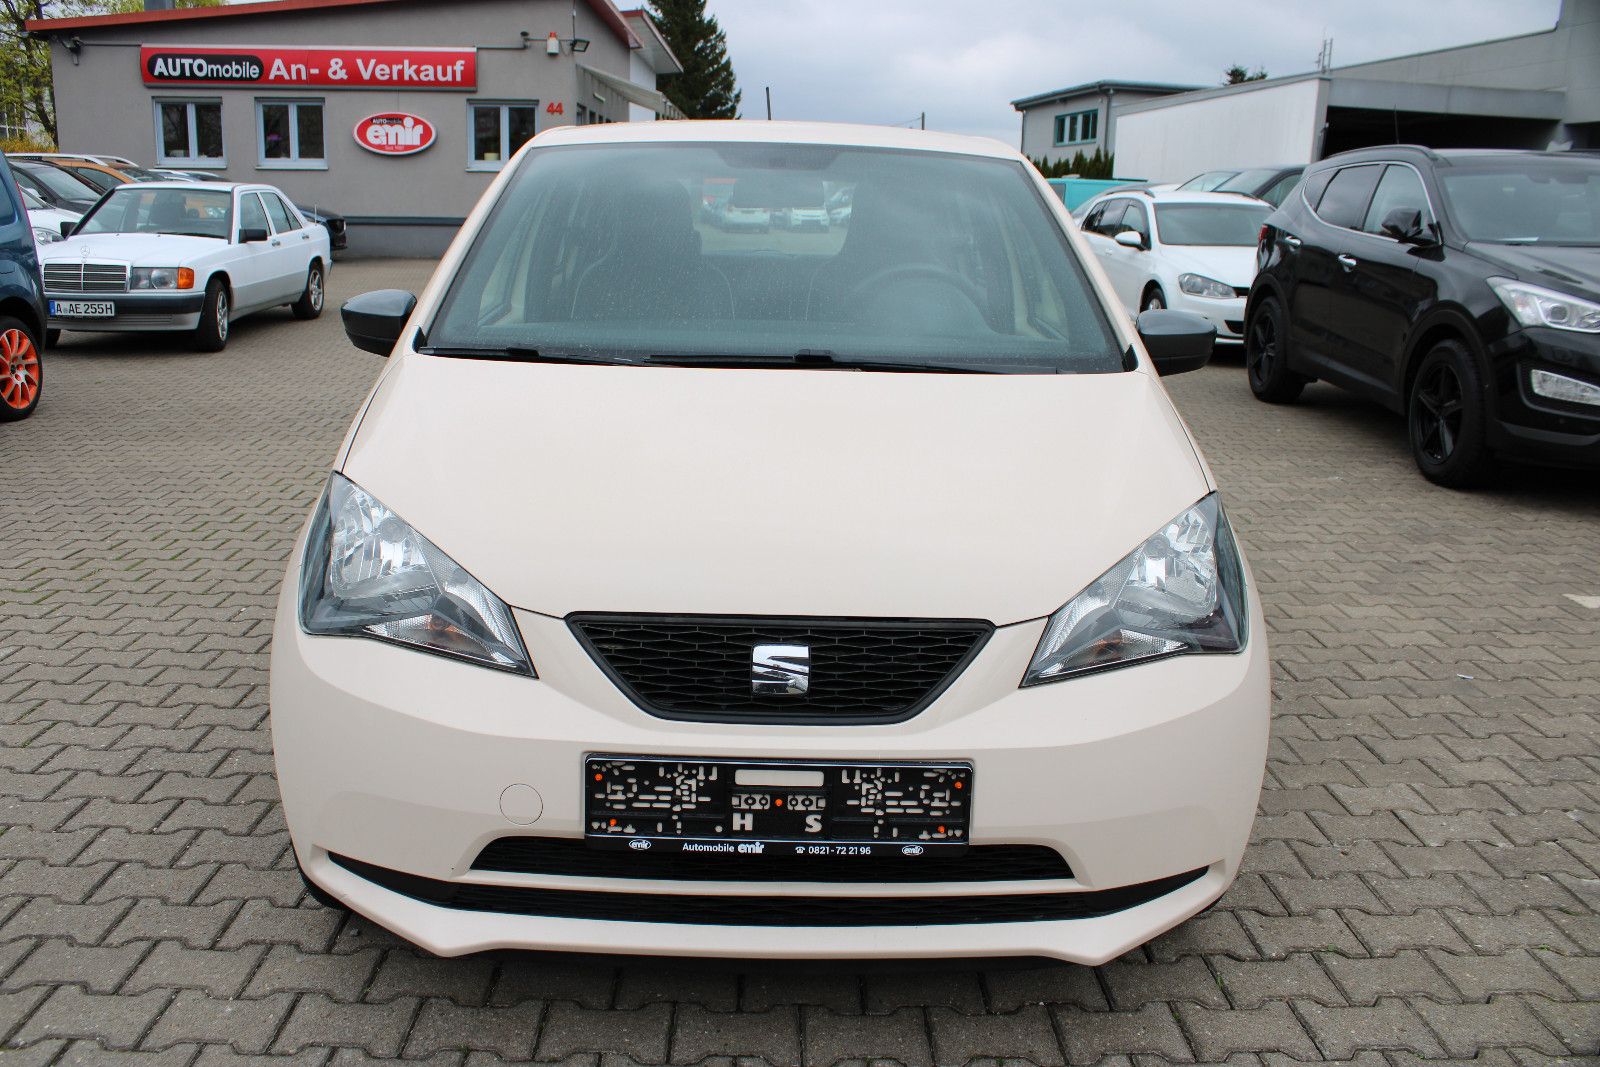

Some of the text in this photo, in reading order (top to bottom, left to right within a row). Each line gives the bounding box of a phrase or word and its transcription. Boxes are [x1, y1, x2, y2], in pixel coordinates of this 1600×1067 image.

[153, 57, 465, 82] AUTOmobile An- & Verkauf
[546, 102, 563, 116] 44
[366, 116, 424, 145] emir
[56, 303, 113, 315] A AE 255H
[682, 841, 765, 854] Automobile emir
